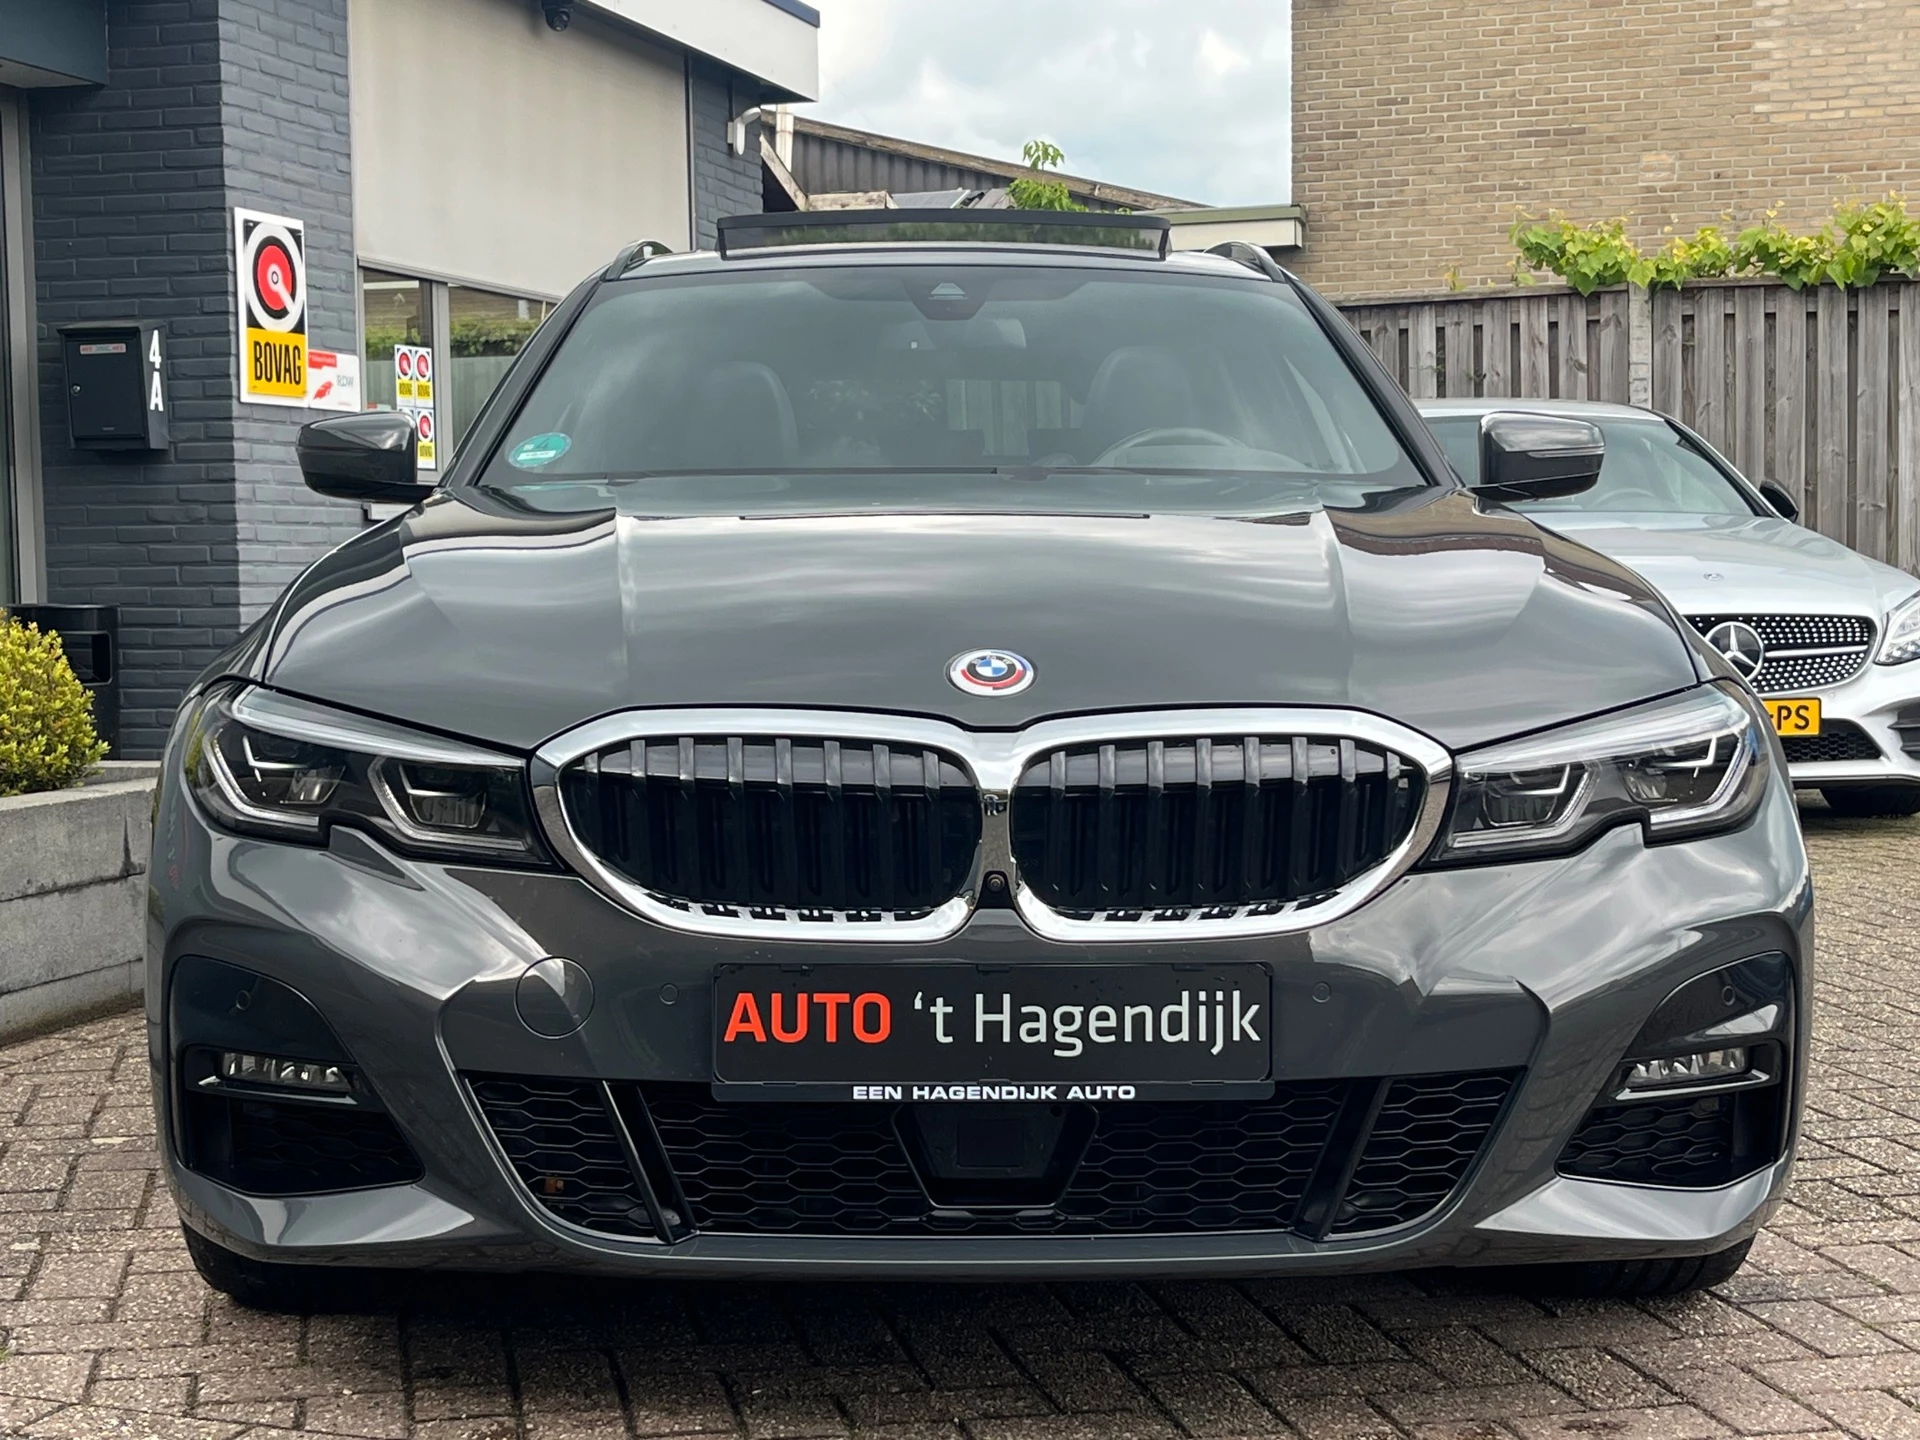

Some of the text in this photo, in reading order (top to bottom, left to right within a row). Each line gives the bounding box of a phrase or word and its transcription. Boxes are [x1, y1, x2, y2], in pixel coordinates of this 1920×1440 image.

[253, 340, 302, 386] BOVAG
[724, 992, 891, 1044] AUTO
[975, 990, 1261, 1057] Hagendijk
[853, 1086, 1136, 1100] EEN HAGENDIJK AUTO
